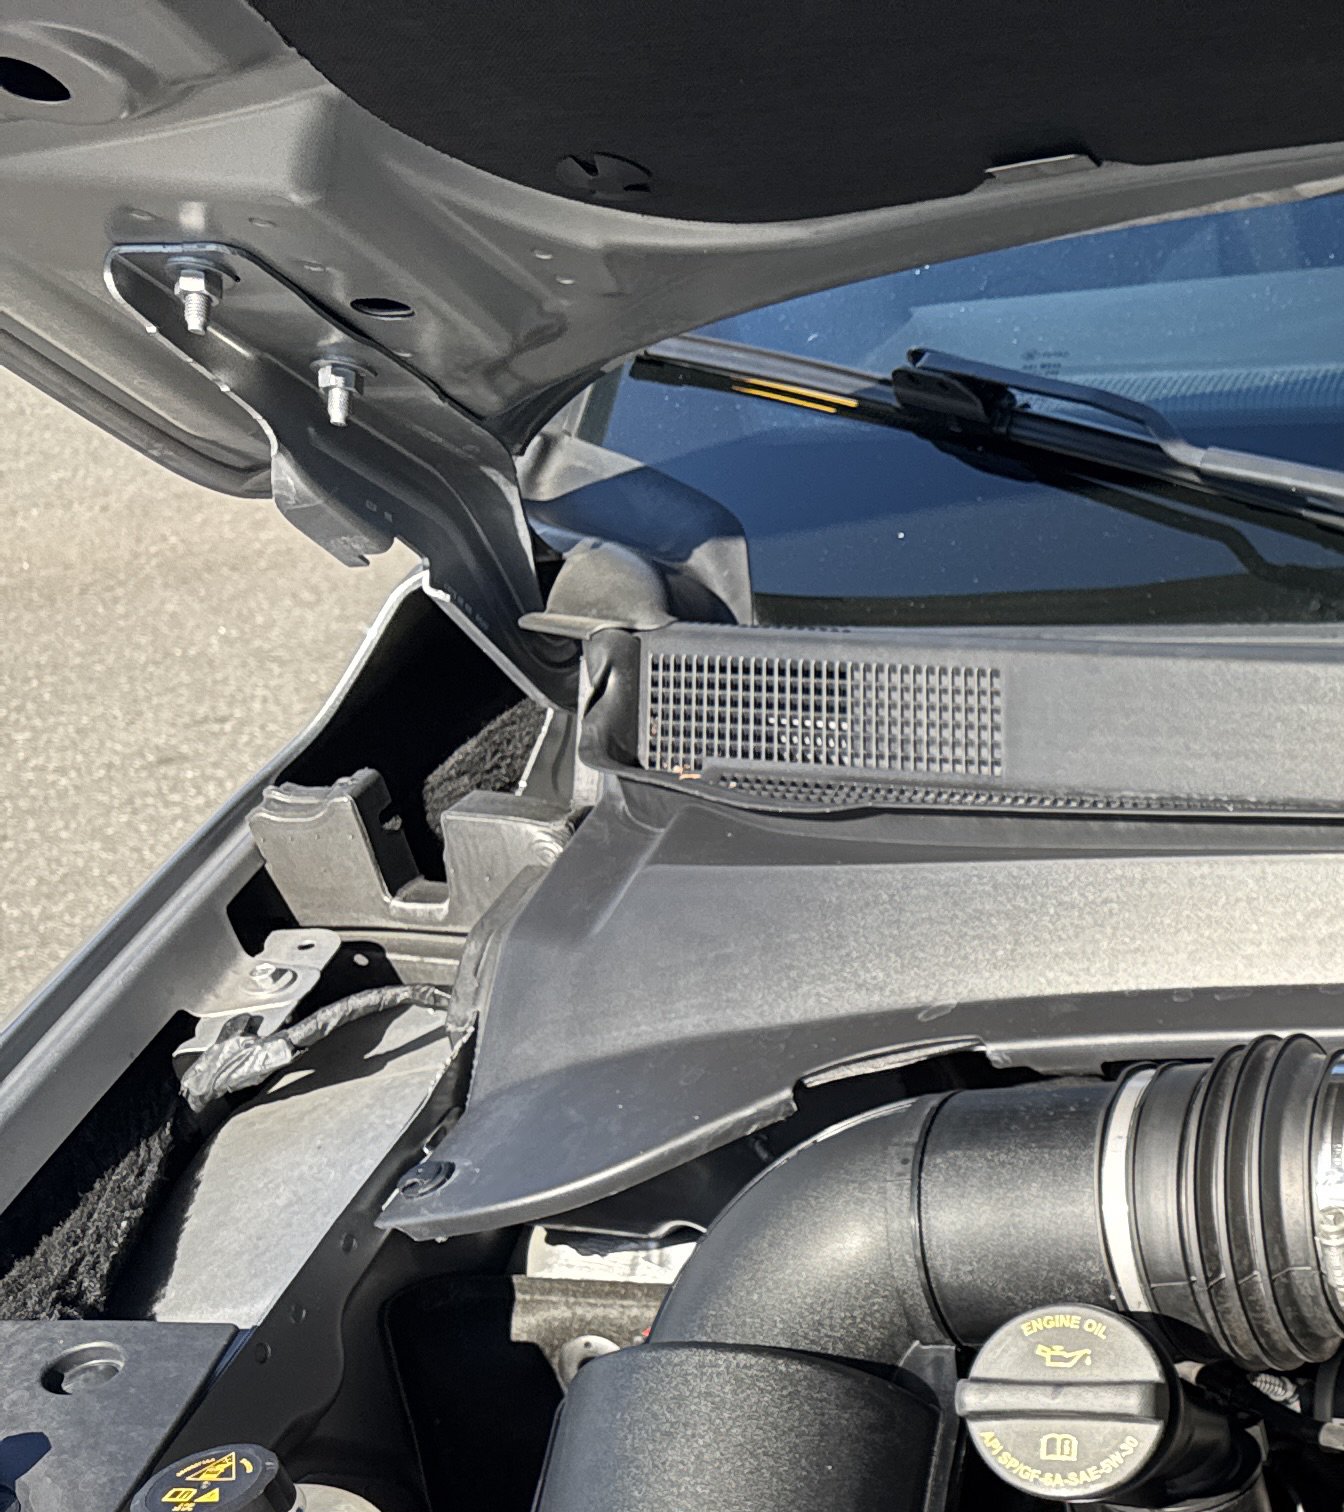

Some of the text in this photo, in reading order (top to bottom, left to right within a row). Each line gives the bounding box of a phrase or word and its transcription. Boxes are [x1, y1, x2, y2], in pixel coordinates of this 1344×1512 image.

[1021, 1315, 1108, 1340] ENGINE OIL
[979, 1430, 1001, 1457] API
